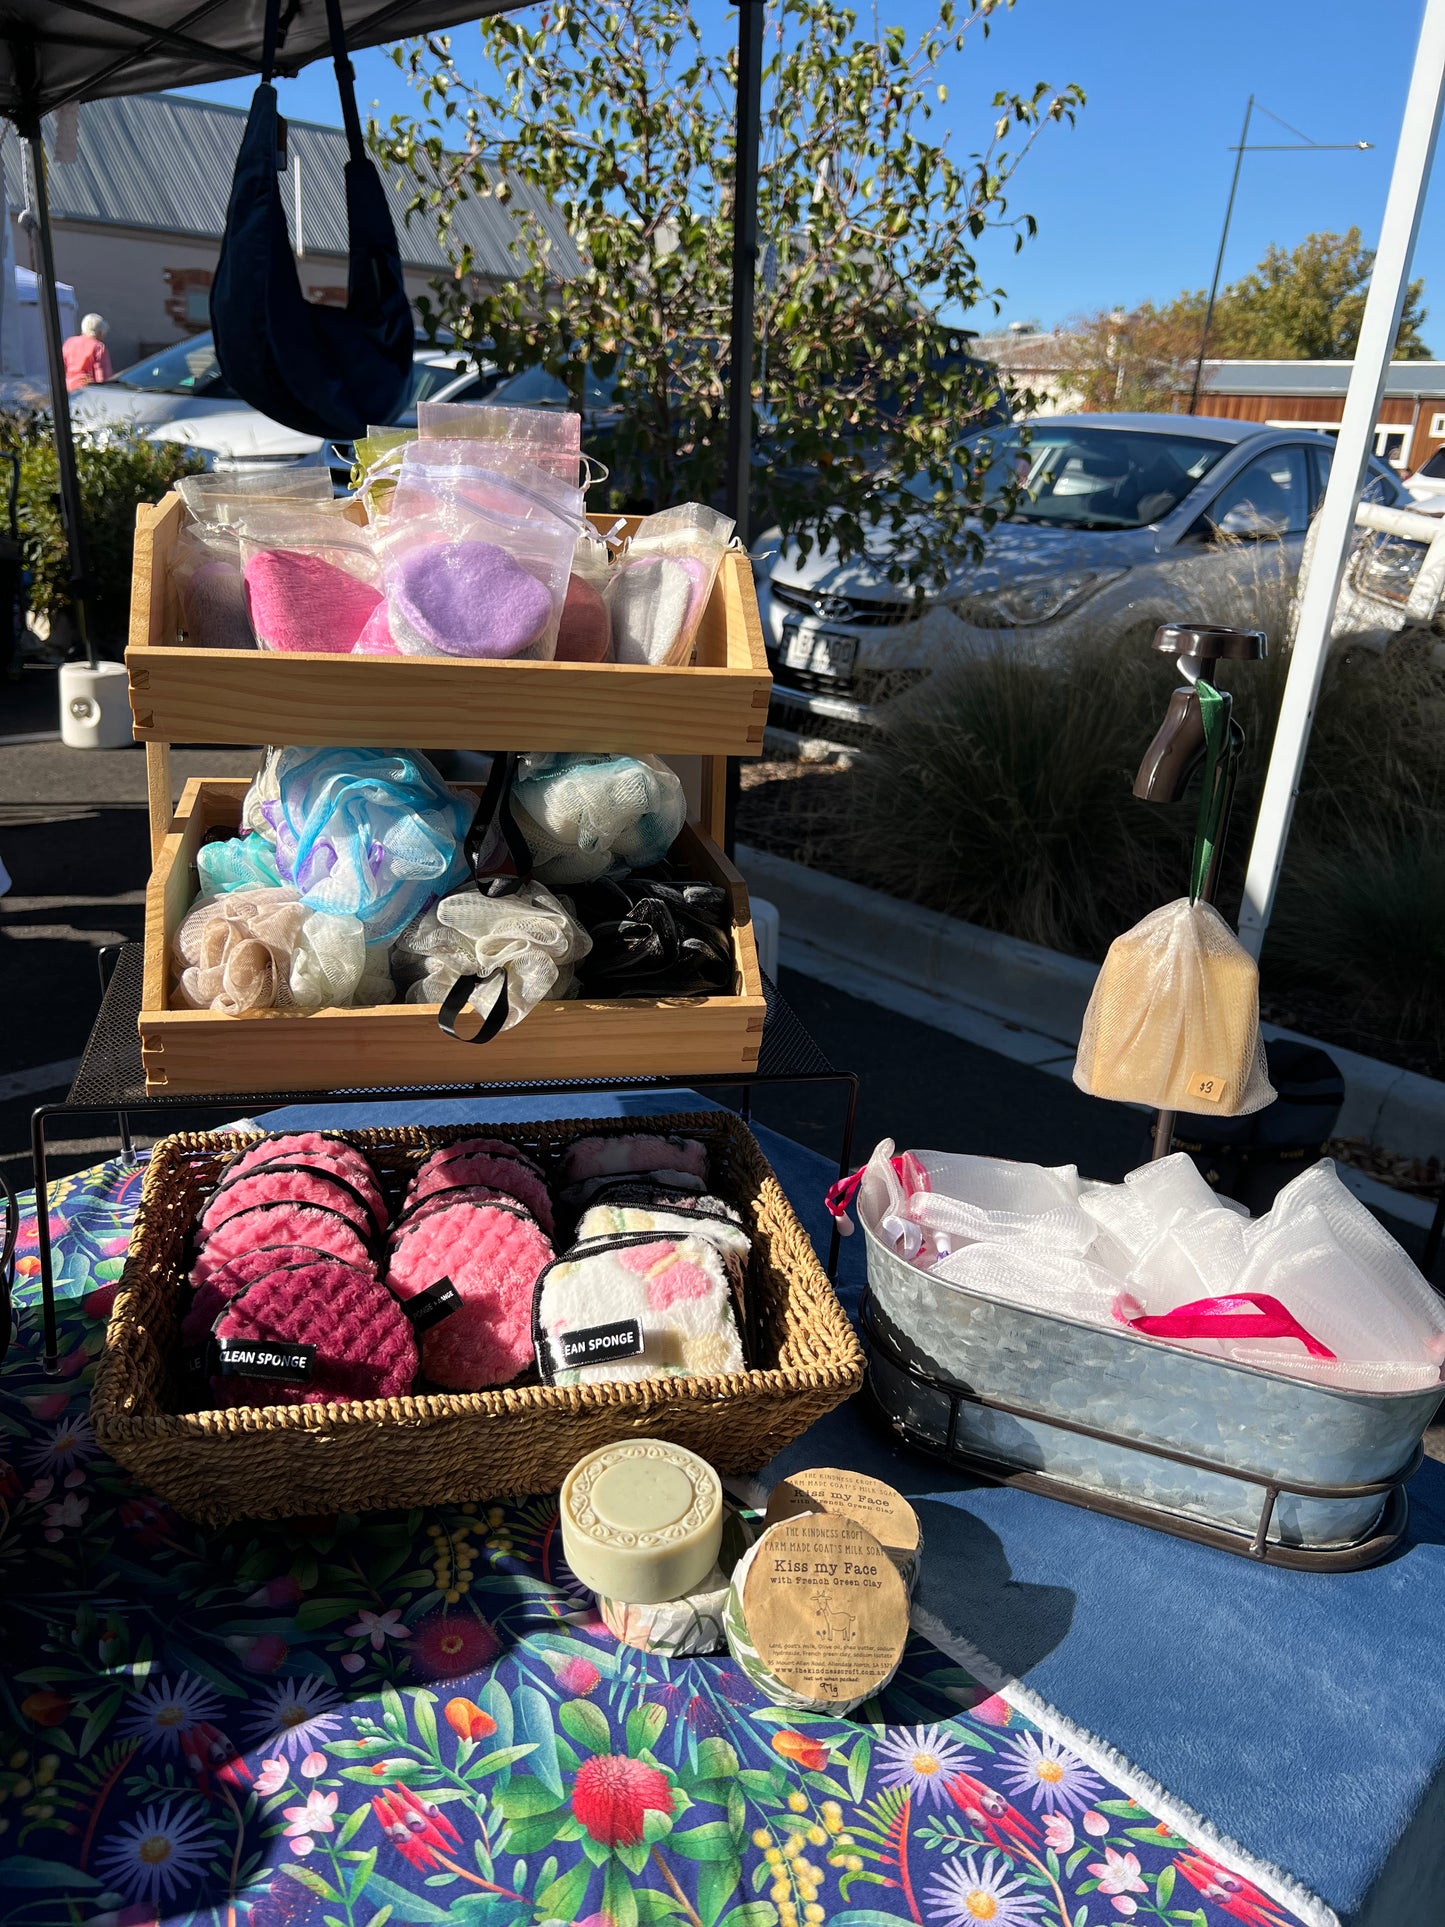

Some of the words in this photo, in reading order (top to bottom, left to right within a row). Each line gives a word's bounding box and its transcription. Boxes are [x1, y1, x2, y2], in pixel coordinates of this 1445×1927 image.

[1200, 1080, 1214, 1094] $3
[564, 1341, 586, 1356] EAN
[588, 1331, 634, 1351] SPONGE
[219, 1350, 256, 1364] CLEAN
[256, 1352, 308, 1369] SPONGE
[820, 1473, 853, 1482] KINDNESS
[856, 1478, 877, 1486] CROFT
[860, 1486, 877, 1494] MILK
[794, 1489, 825, 1497] Kiss
[831, 1492, 852, 1502] my
[858, 1494, 890, 1507] Face
[814, 1498, 844, 1507] French
[848, 1502, 873, 1510] Green
[786, 1527, 799, 1537] THE
[802, 1528, 839, 1538] KINDNESS
[842, 1530, 864, 1540] CROFT
[764, 1541, 787, 1552] FARM
[790, 1542, 811, 1552] MADE
[814, 1543, 842, 1554] GOAT'S
[845, 1545, 864, 1556] MILK
[774, 1560, 808, 1572] Kiss
[814, 1562, 838, 1576] my
[844, 1562, 878, 1576] Face
[795, 1576, 830, 1585] French
[833, 1578, 860, 1586] Green
[863, 1579, 882, 1588] Clay
[775, 1668, 886, 1676] www.thekindnesscroft.com.au
